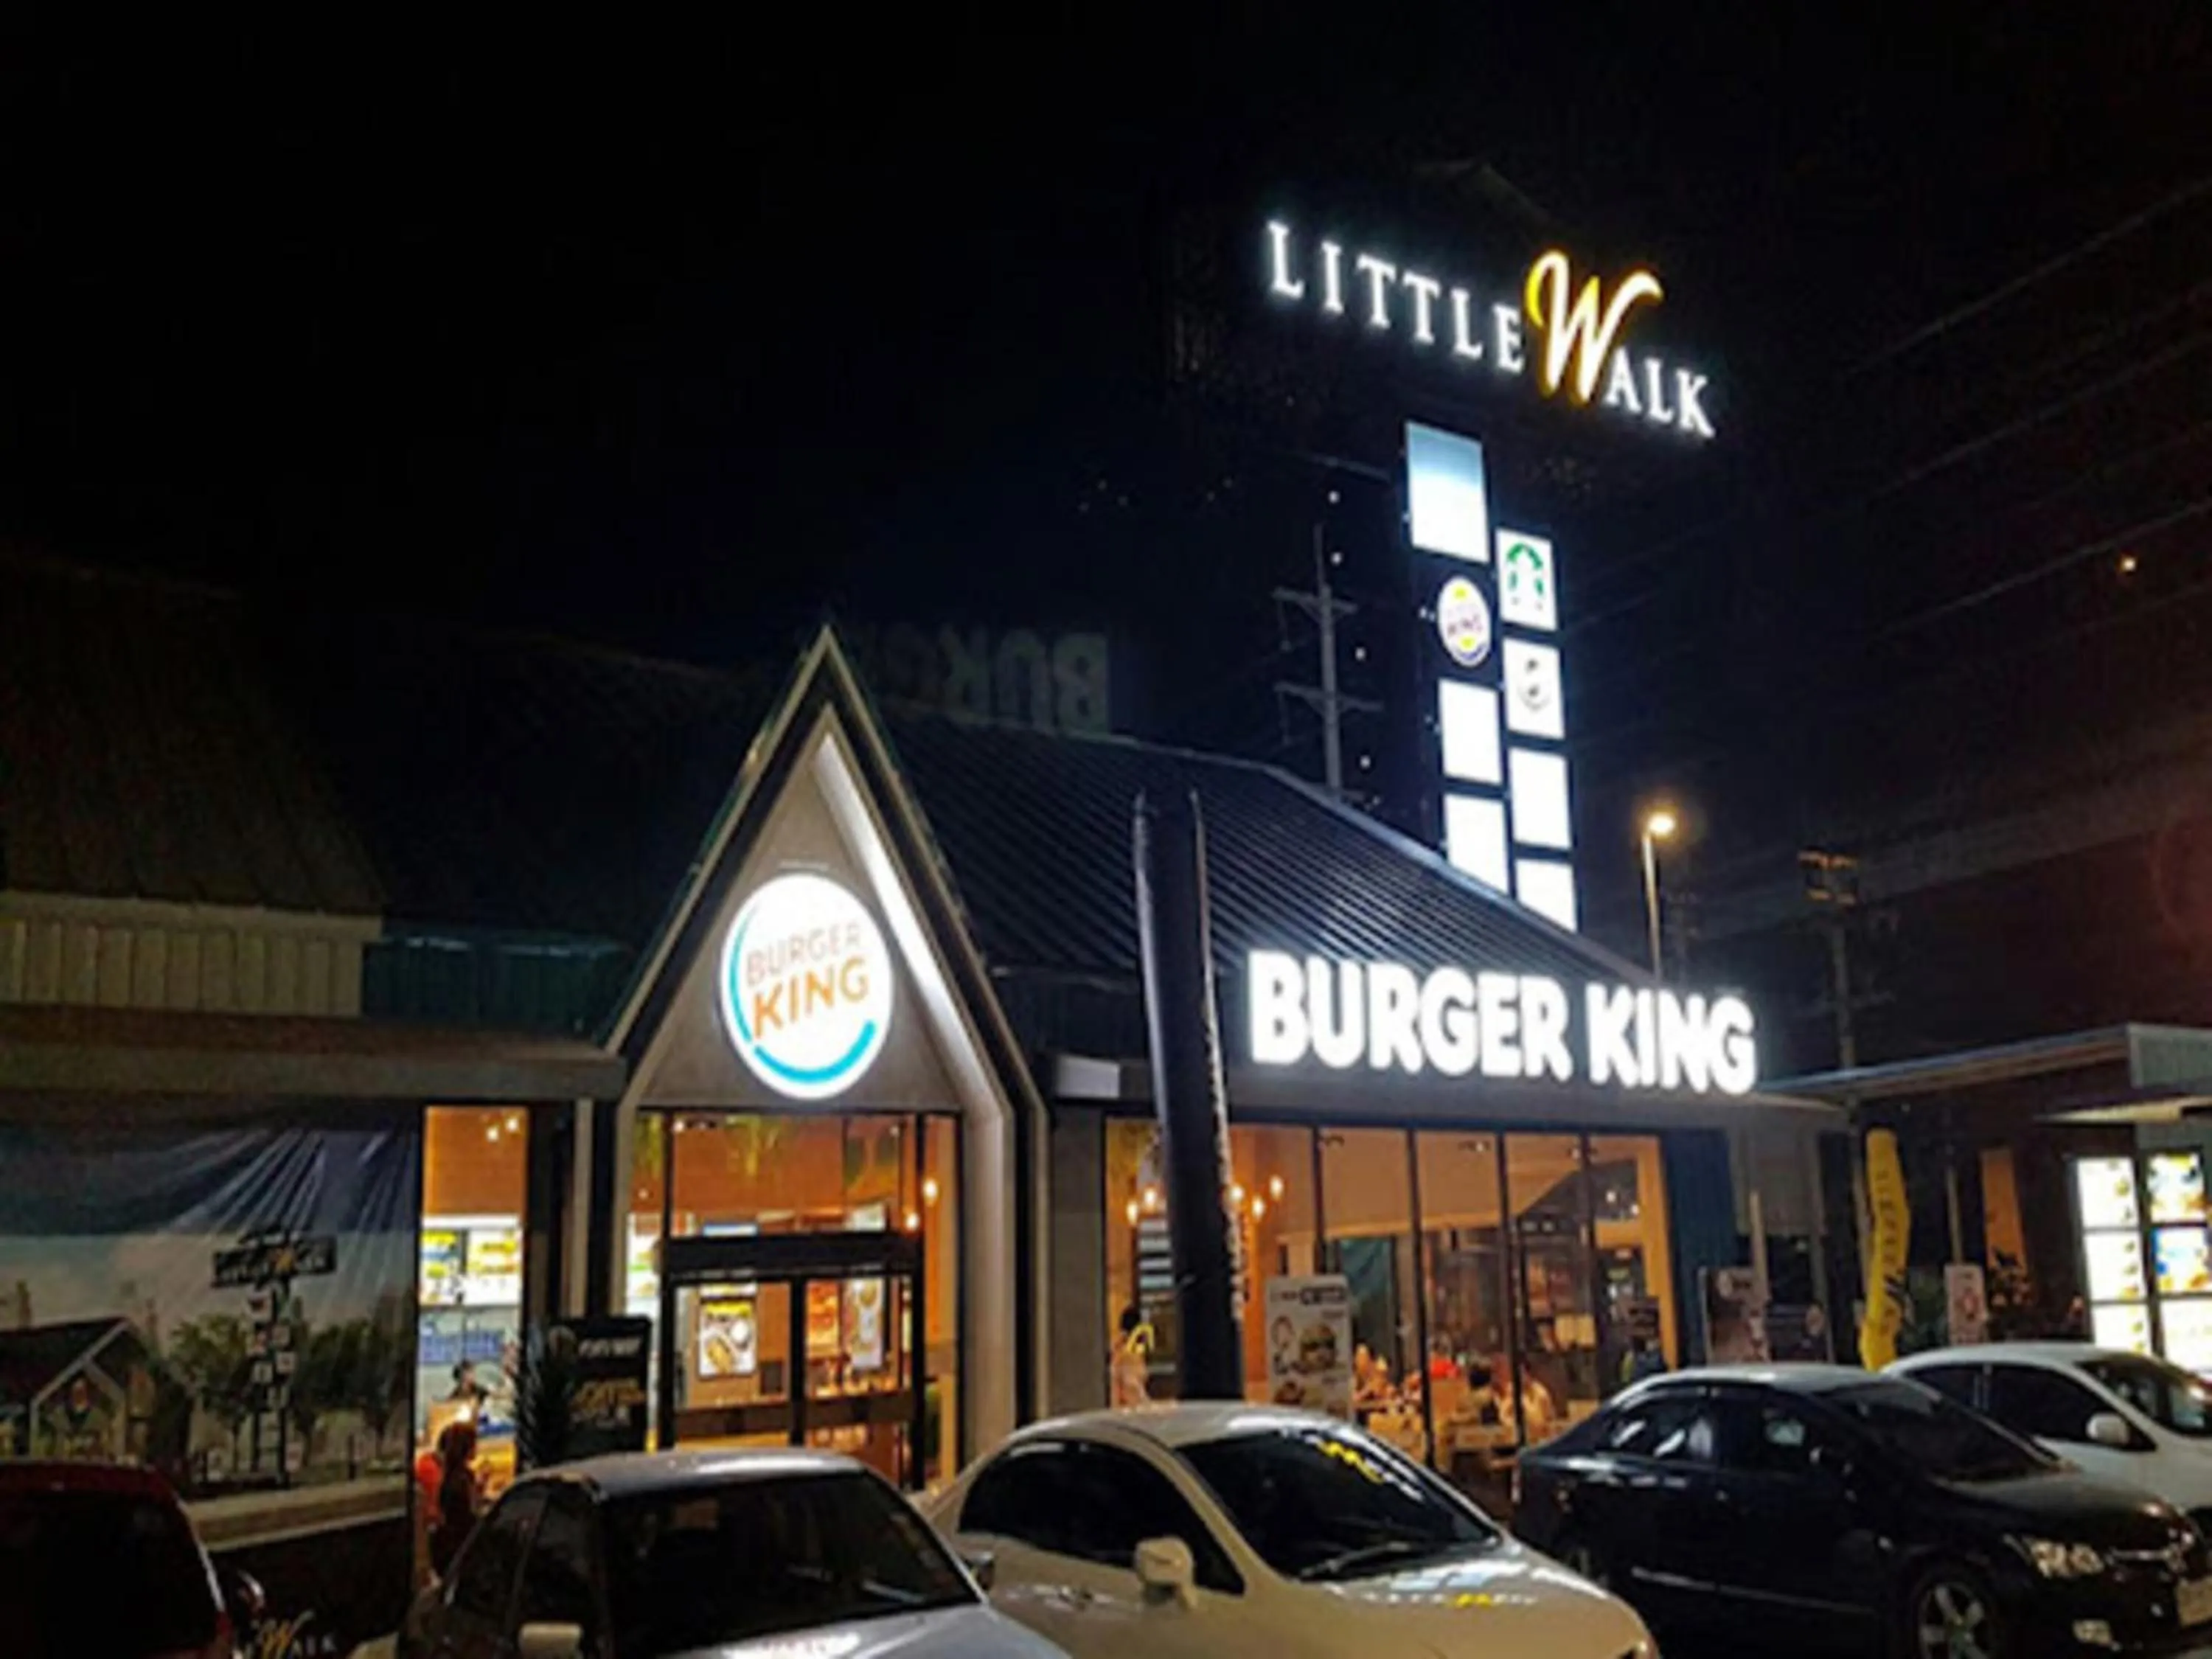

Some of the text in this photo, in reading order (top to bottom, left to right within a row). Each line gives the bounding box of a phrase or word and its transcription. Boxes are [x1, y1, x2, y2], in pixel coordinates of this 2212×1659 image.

[1268, 220, 1716, 438] LITTLE WALK
[746, 921, 861, 988] BURGER
[752, 956, 869, 1040] KING
[1248, 949, 1758, 1096] BURGER KING
